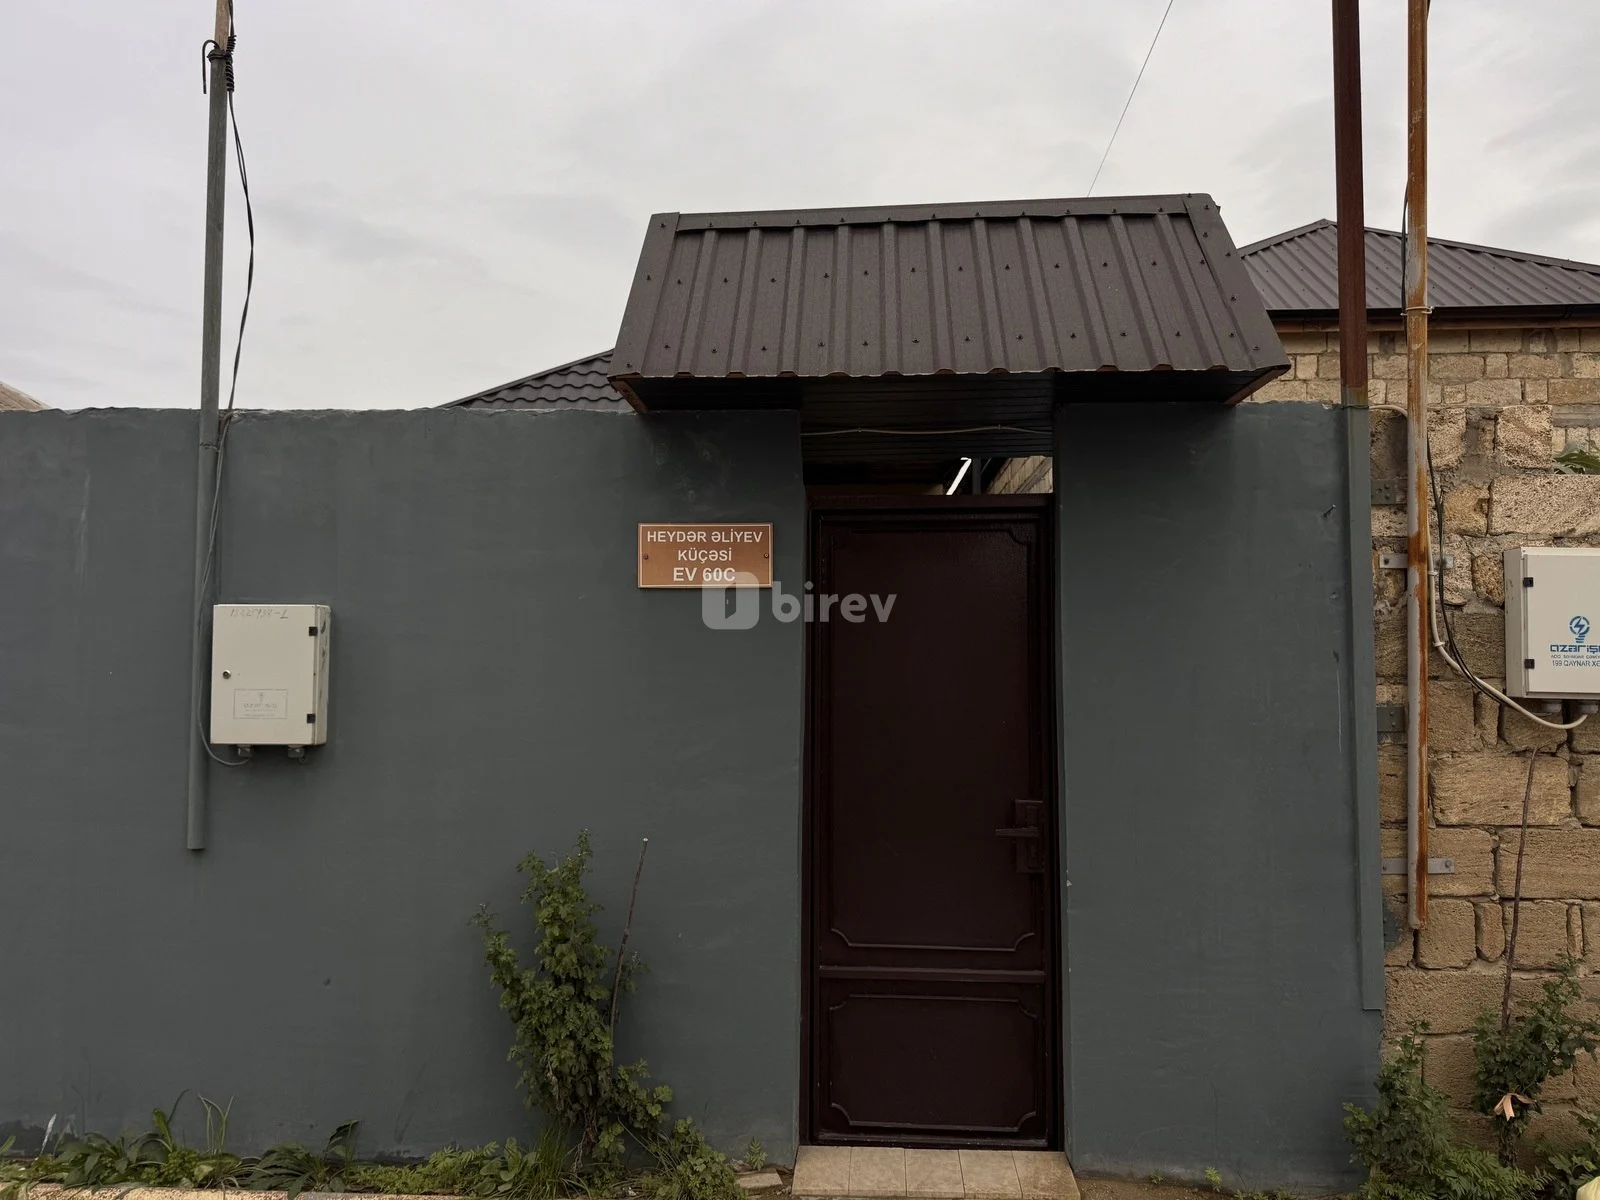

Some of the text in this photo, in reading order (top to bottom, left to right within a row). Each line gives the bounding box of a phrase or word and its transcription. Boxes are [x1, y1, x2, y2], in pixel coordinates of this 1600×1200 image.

[647, 528, 763, 543] HEYDƏR ƏLİYEV
[678, 547, 732, 564] KÜÇƏSİ
[673, 567, 736, 582] EV 60C
